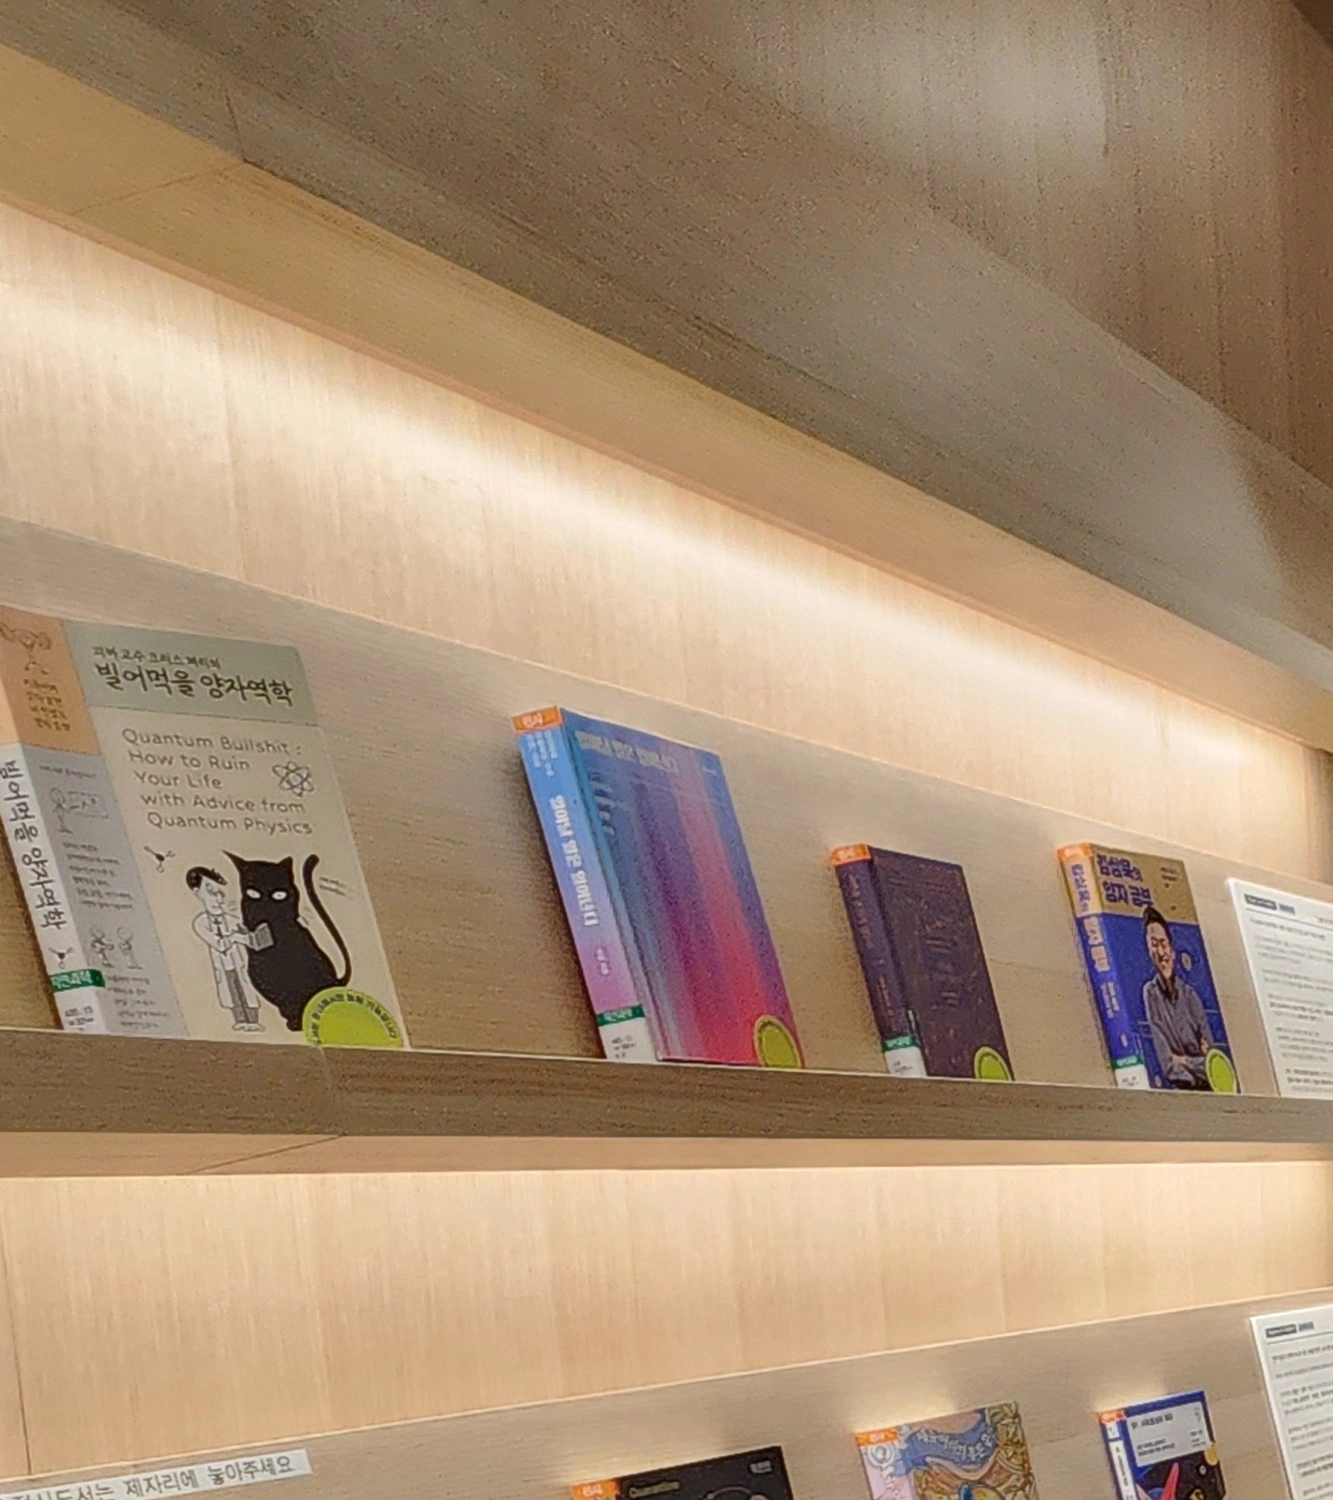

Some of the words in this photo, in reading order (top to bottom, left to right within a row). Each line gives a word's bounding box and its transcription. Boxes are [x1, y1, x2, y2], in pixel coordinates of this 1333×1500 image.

[94, 662, 196, 698] 빌어먹을
[200, 672, 294, 707] 양자역학
[122, 728, 213, 748] Quantum
[220, 736, 289, 755] Bullshit
[128, 750, 174, 766] How
[181, 753, 201, 768] to
[209, 755, 250, 771] Ruin
[134, 771, 179, 787] Your
[187, 774, 222, 790] Life
[140, 791, 184, 807] with
[193, 794, 256, 812] Advice
[261, 799, 305, 814] from
[147, 812, 236, 830] Quantum
[244, 817, 313, 836] Physics
[0, 760, 39, 842] 빌어먹을
[21, 847, 68, 931] 양자역학
[123, 1469, 198, 1497] 제자리에
[207, 1455, 296, 1486] 놓아주세요
